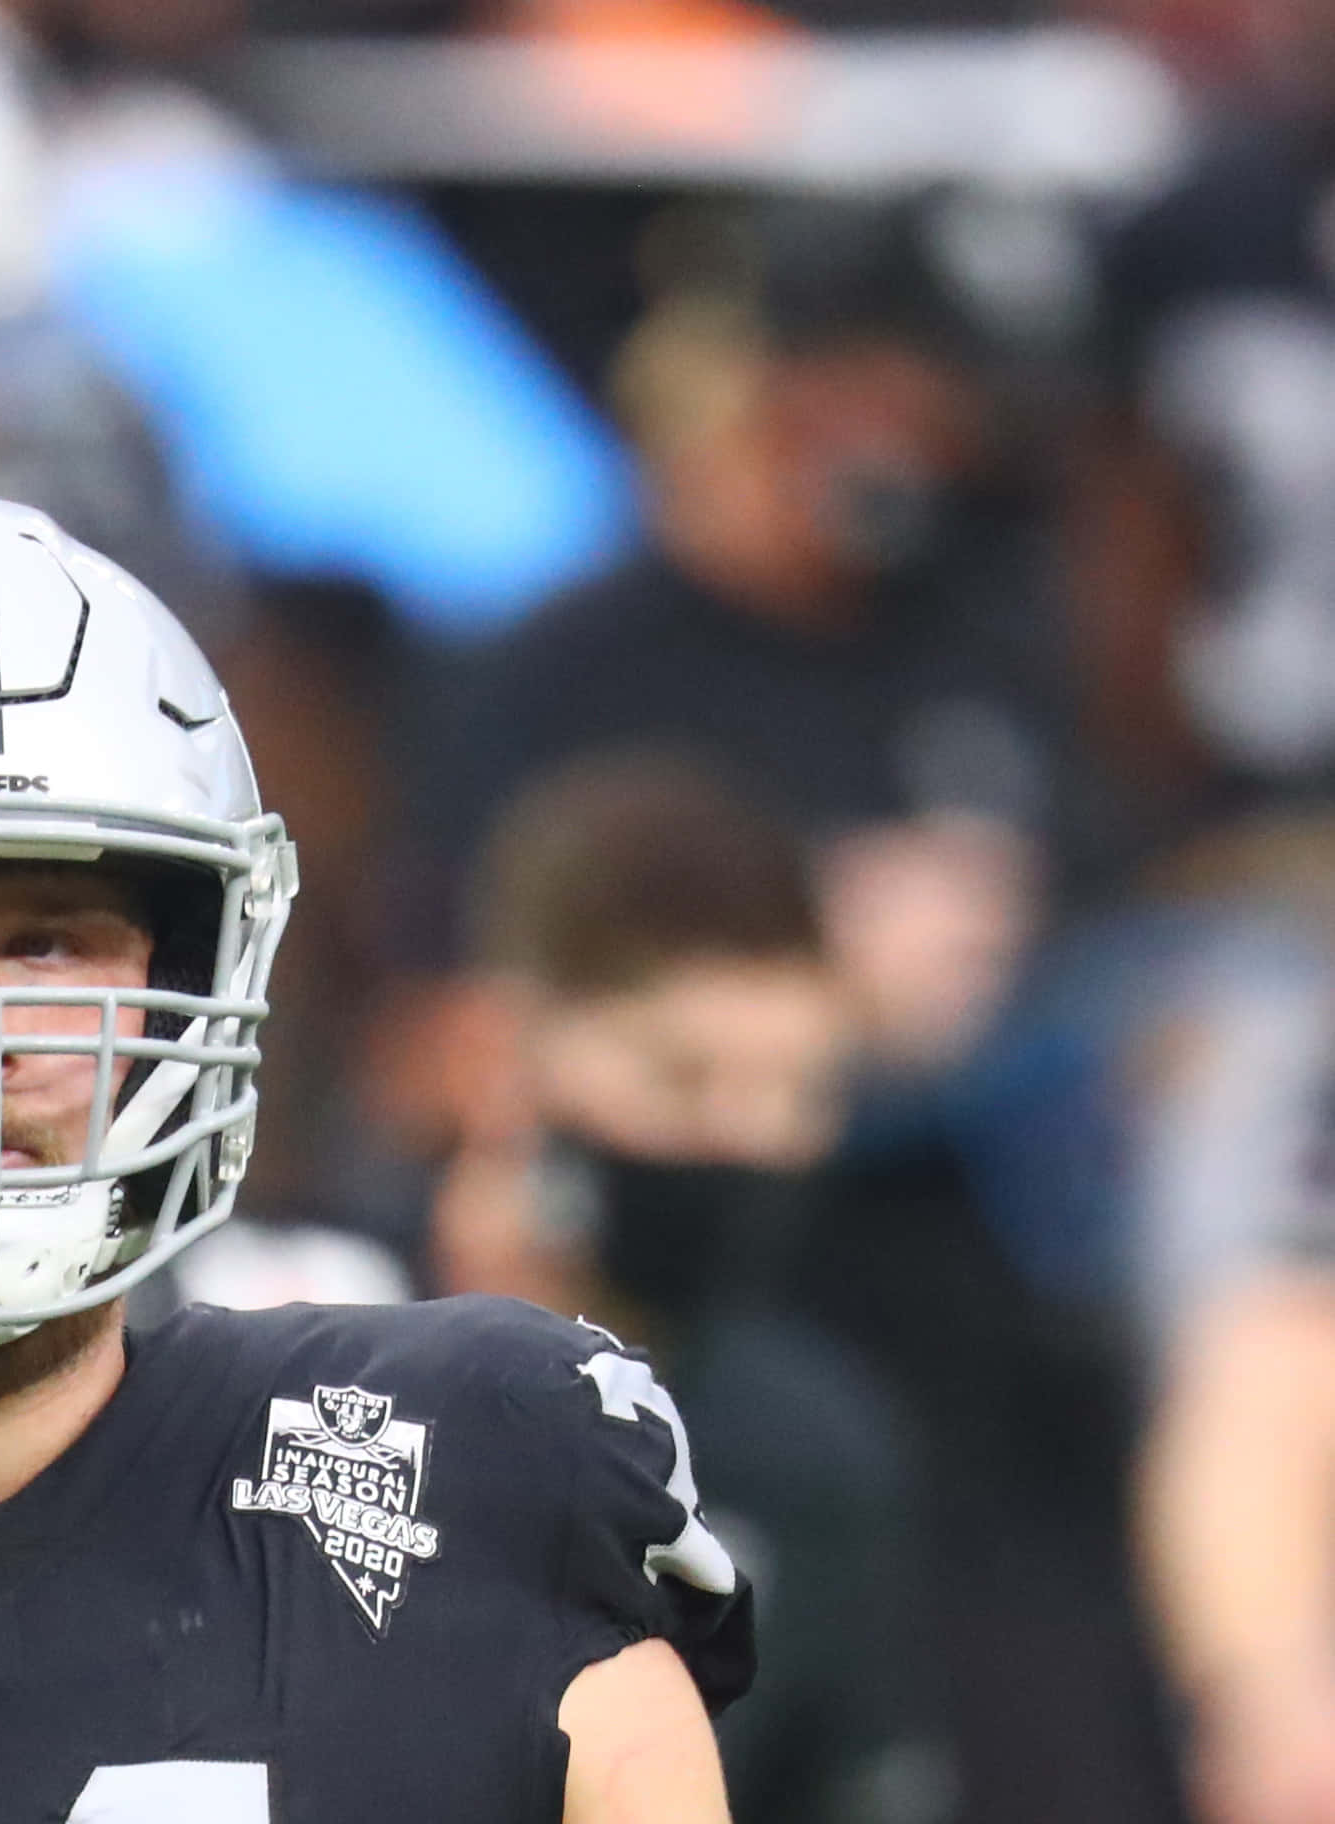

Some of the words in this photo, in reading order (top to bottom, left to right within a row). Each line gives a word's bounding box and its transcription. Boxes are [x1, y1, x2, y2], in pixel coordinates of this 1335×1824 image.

[273, 1465, 405, 1512] SEASON
[276, 1449, 407, 1490] INAUGURAL
[233, 1478, 312, 1513] LAS
[312, 1488, 438, 1558] VEGAS
[324, 1529, 405, 1578] 2020
